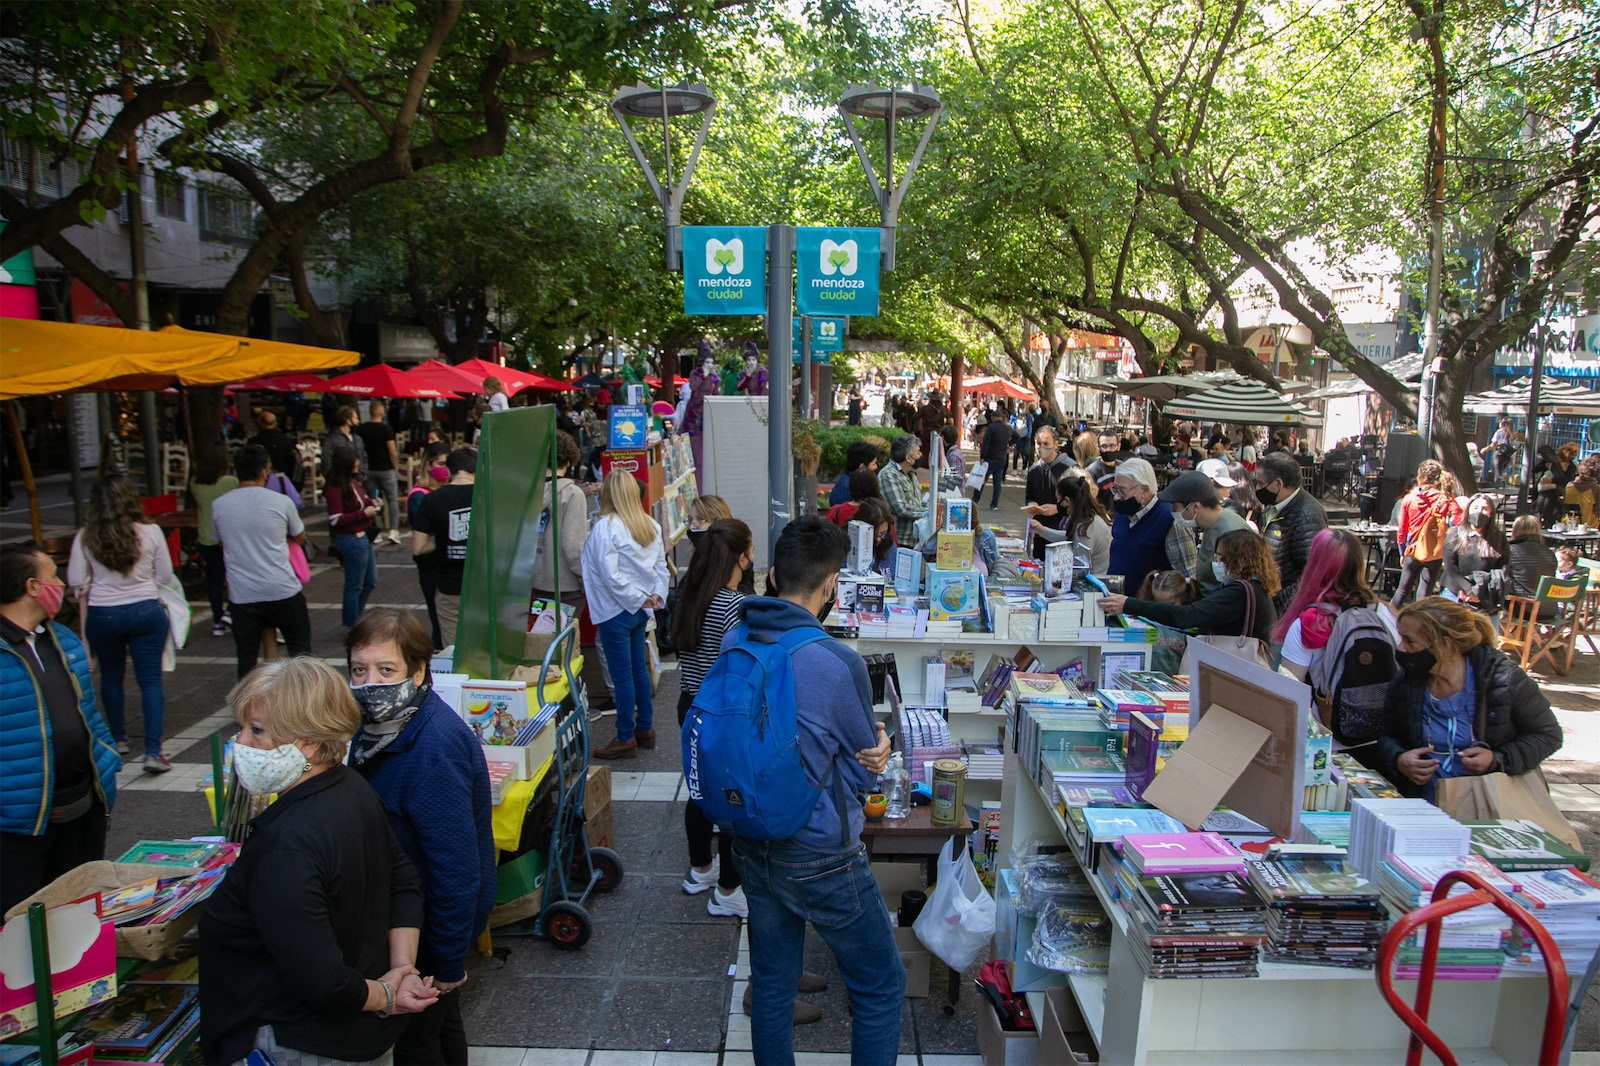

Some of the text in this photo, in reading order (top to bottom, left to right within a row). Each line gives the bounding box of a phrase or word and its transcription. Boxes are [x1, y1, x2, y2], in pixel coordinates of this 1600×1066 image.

[698, 276, 752, 288] mendoza
[812, 278, 864, 288] mendoza
[707, 288, 743, 300] ciudad
[820, 290, 856, 300] ciudad
